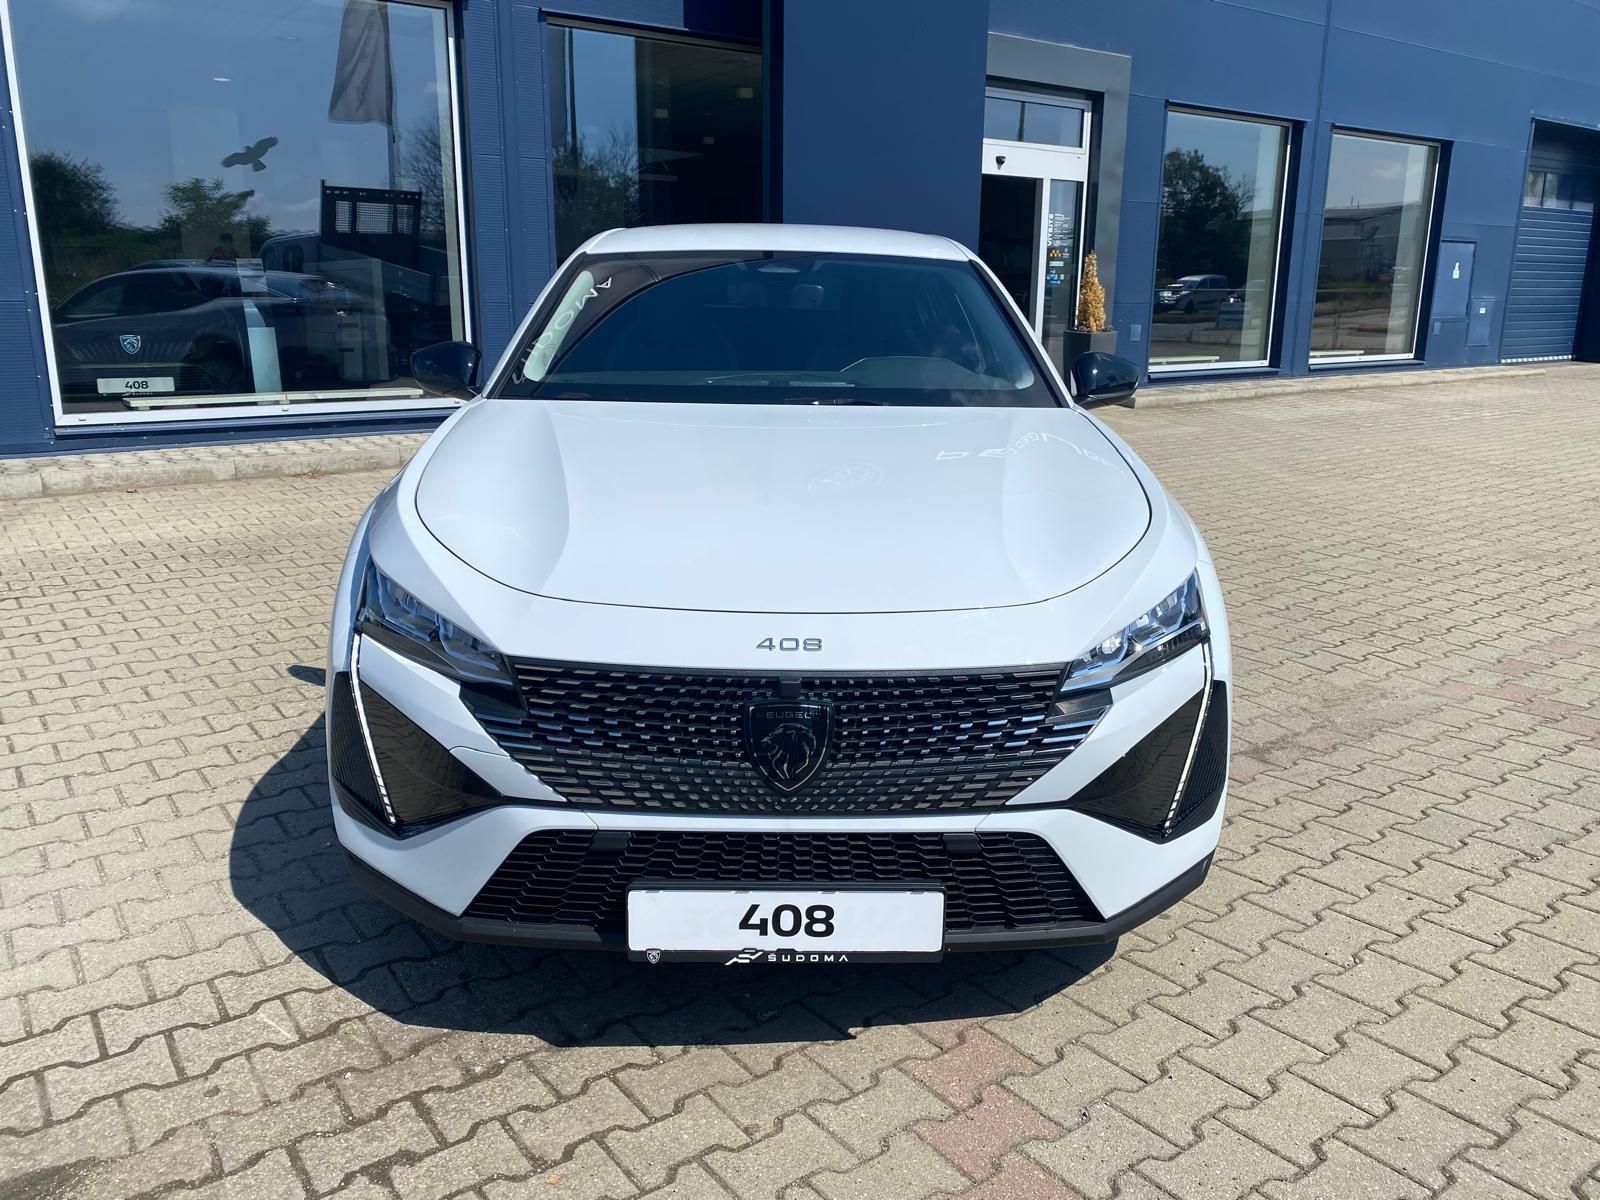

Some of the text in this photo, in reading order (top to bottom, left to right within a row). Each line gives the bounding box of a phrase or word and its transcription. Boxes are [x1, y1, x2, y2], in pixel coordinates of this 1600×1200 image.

[125, 381, 149, 389] 408
[756, 637, 823, 652] 408
[738, 904, 835, 938] 408
[767, 953, 849, 962] SUDOMA
